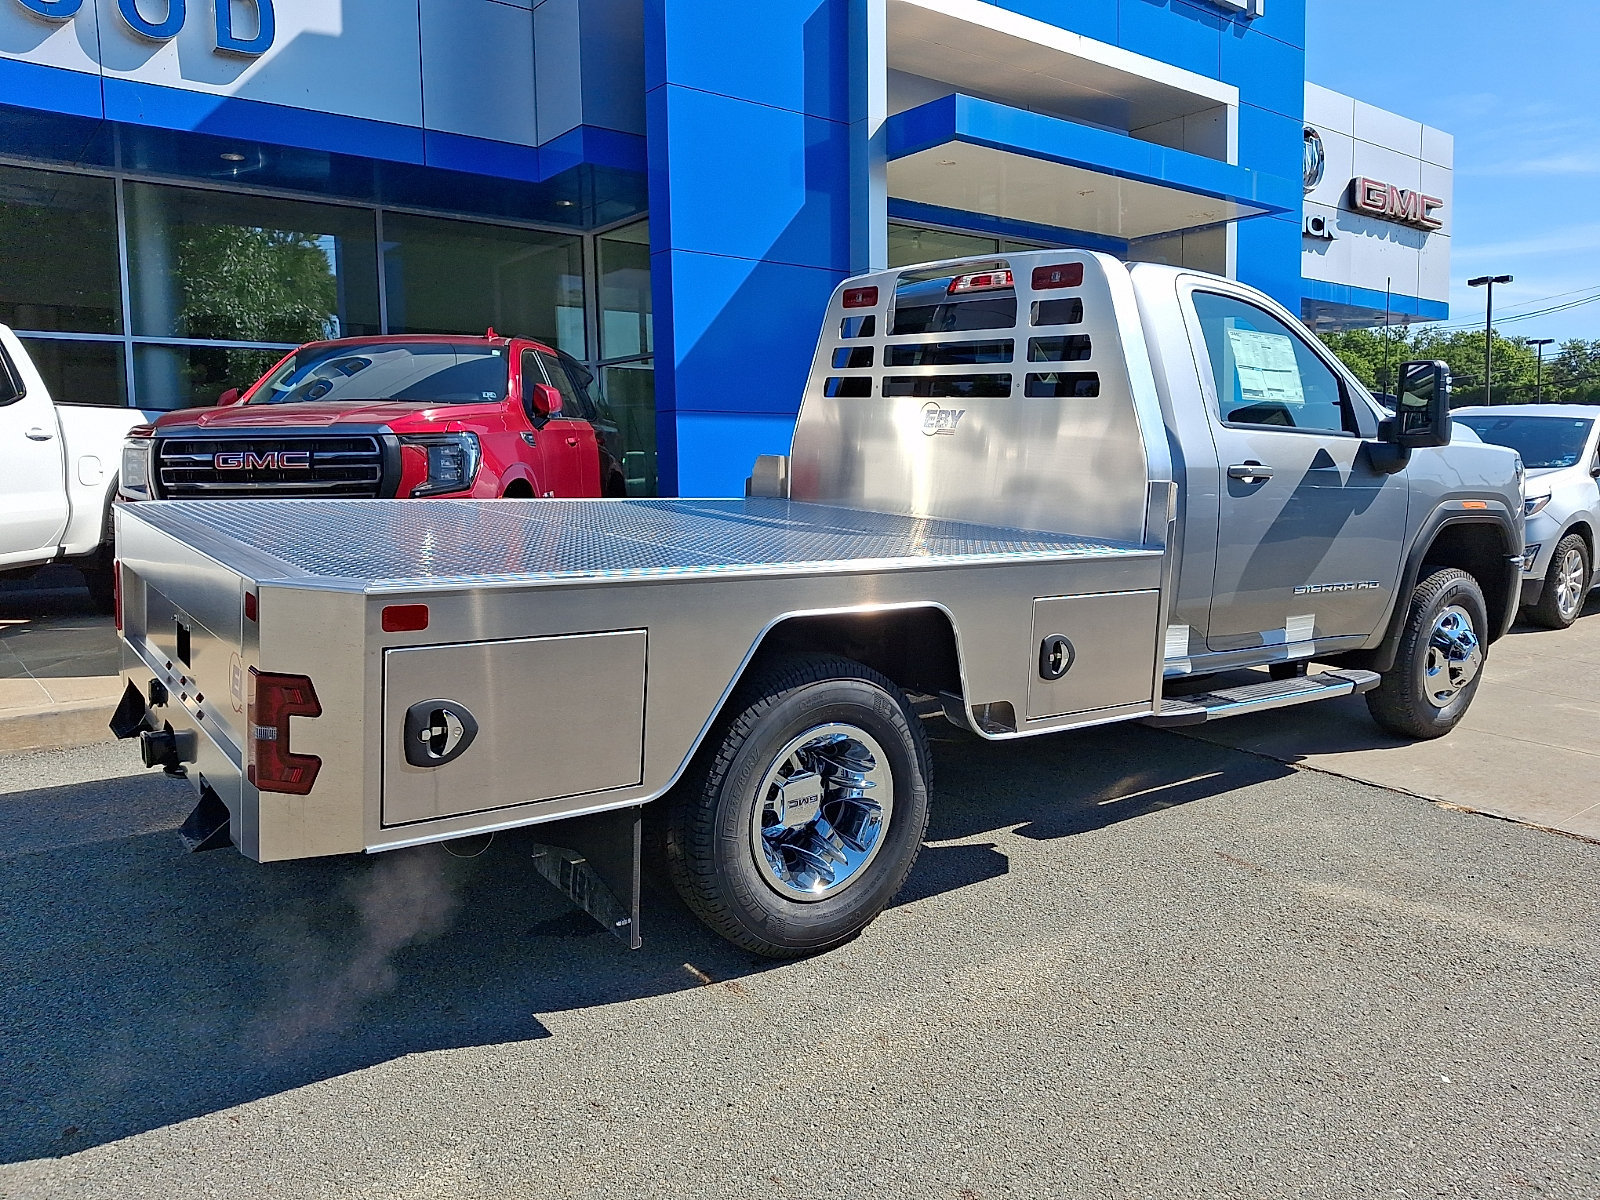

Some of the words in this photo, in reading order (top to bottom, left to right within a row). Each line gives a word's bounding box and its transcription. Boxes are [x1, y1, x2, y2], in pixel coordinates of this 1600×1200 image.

[16, 0, 276, 57] OD
[1354, 175, 1444, 231] GMC
[923, 409, 966, 428] EBY
[215, 451, 310, 470] GMC
[1293, 582, 1356, 595] SIERRA
[786, 794, 818, 809] GMC
